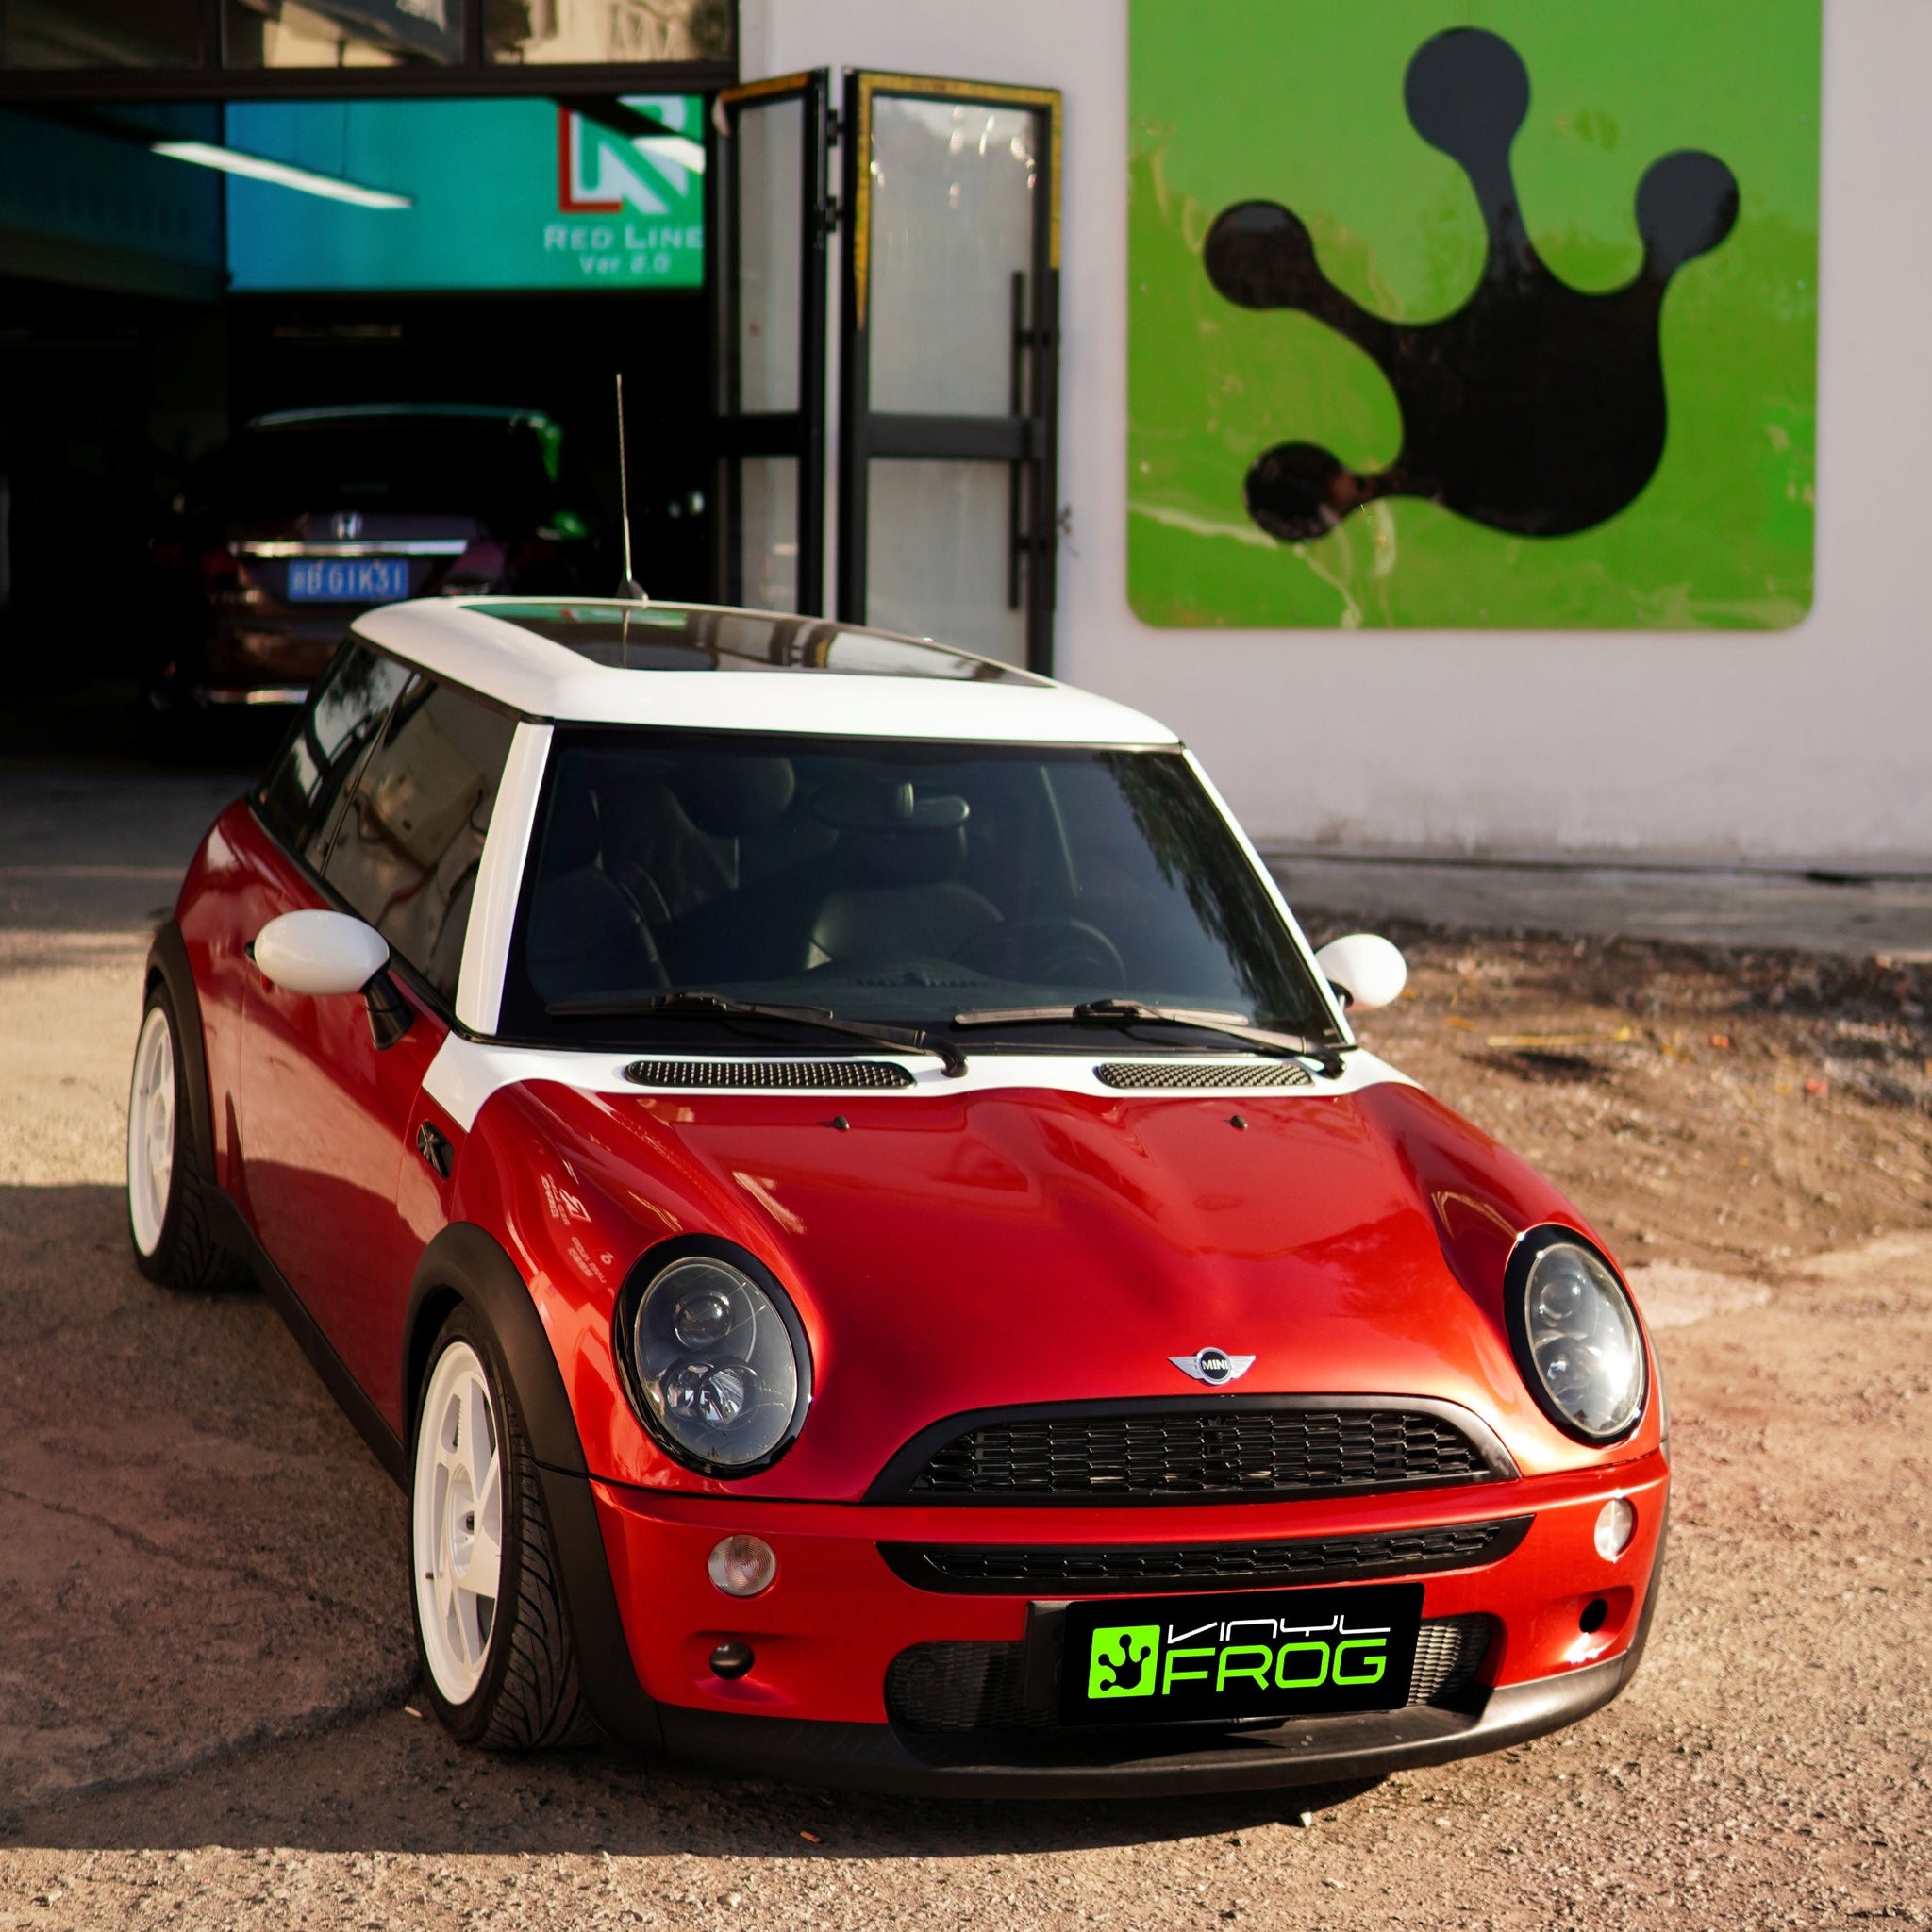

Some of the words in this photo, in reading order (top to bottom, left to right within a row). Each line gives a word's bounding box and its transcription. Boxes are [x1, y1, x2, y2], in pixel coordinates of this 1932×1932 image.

[544, 224, 614, 250] RED
[624, 224, 704, 249] LINE
[579, 255, 621, 275] Ver
[1201, 1358, 1228, 1371] MINI
[1161, 1638, 1387, 1695] FROG
